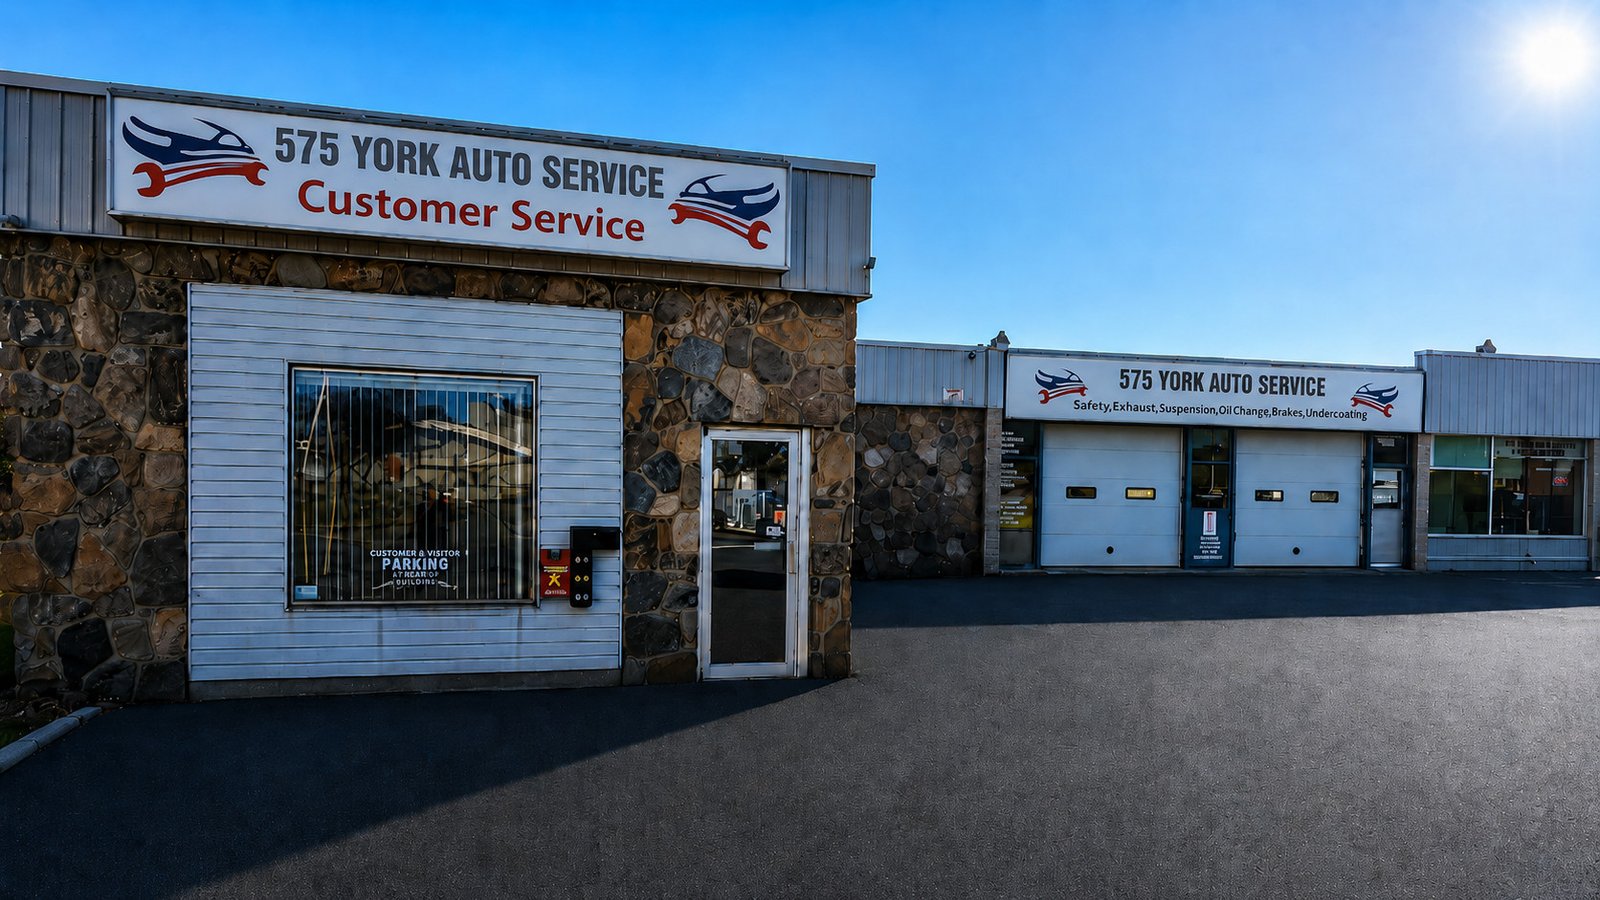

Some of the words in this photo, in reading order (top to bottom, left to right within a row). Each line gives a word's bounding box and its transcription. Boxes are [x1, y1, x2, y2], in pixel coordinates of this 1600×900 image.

[274, 126, 341, 167] 575
[351, 134, 441, 178] YORK
[448, 145, 532, 187] AUTO
[541, 154, 665, 200] SERVICE
[297, 179, 498, 228] Customer
[511, 199, 646, 242] Service
[1119, 368, 1153, 391] 575
[1158, 369, 1205, 393] YORK
[1208, 372, 1253, 395] AUTO
[1257, 374, 1326, 397] SERVICE
[369, 549, 417, 557] CUSTOMER
[382, 557, 449, 571] PARKING
